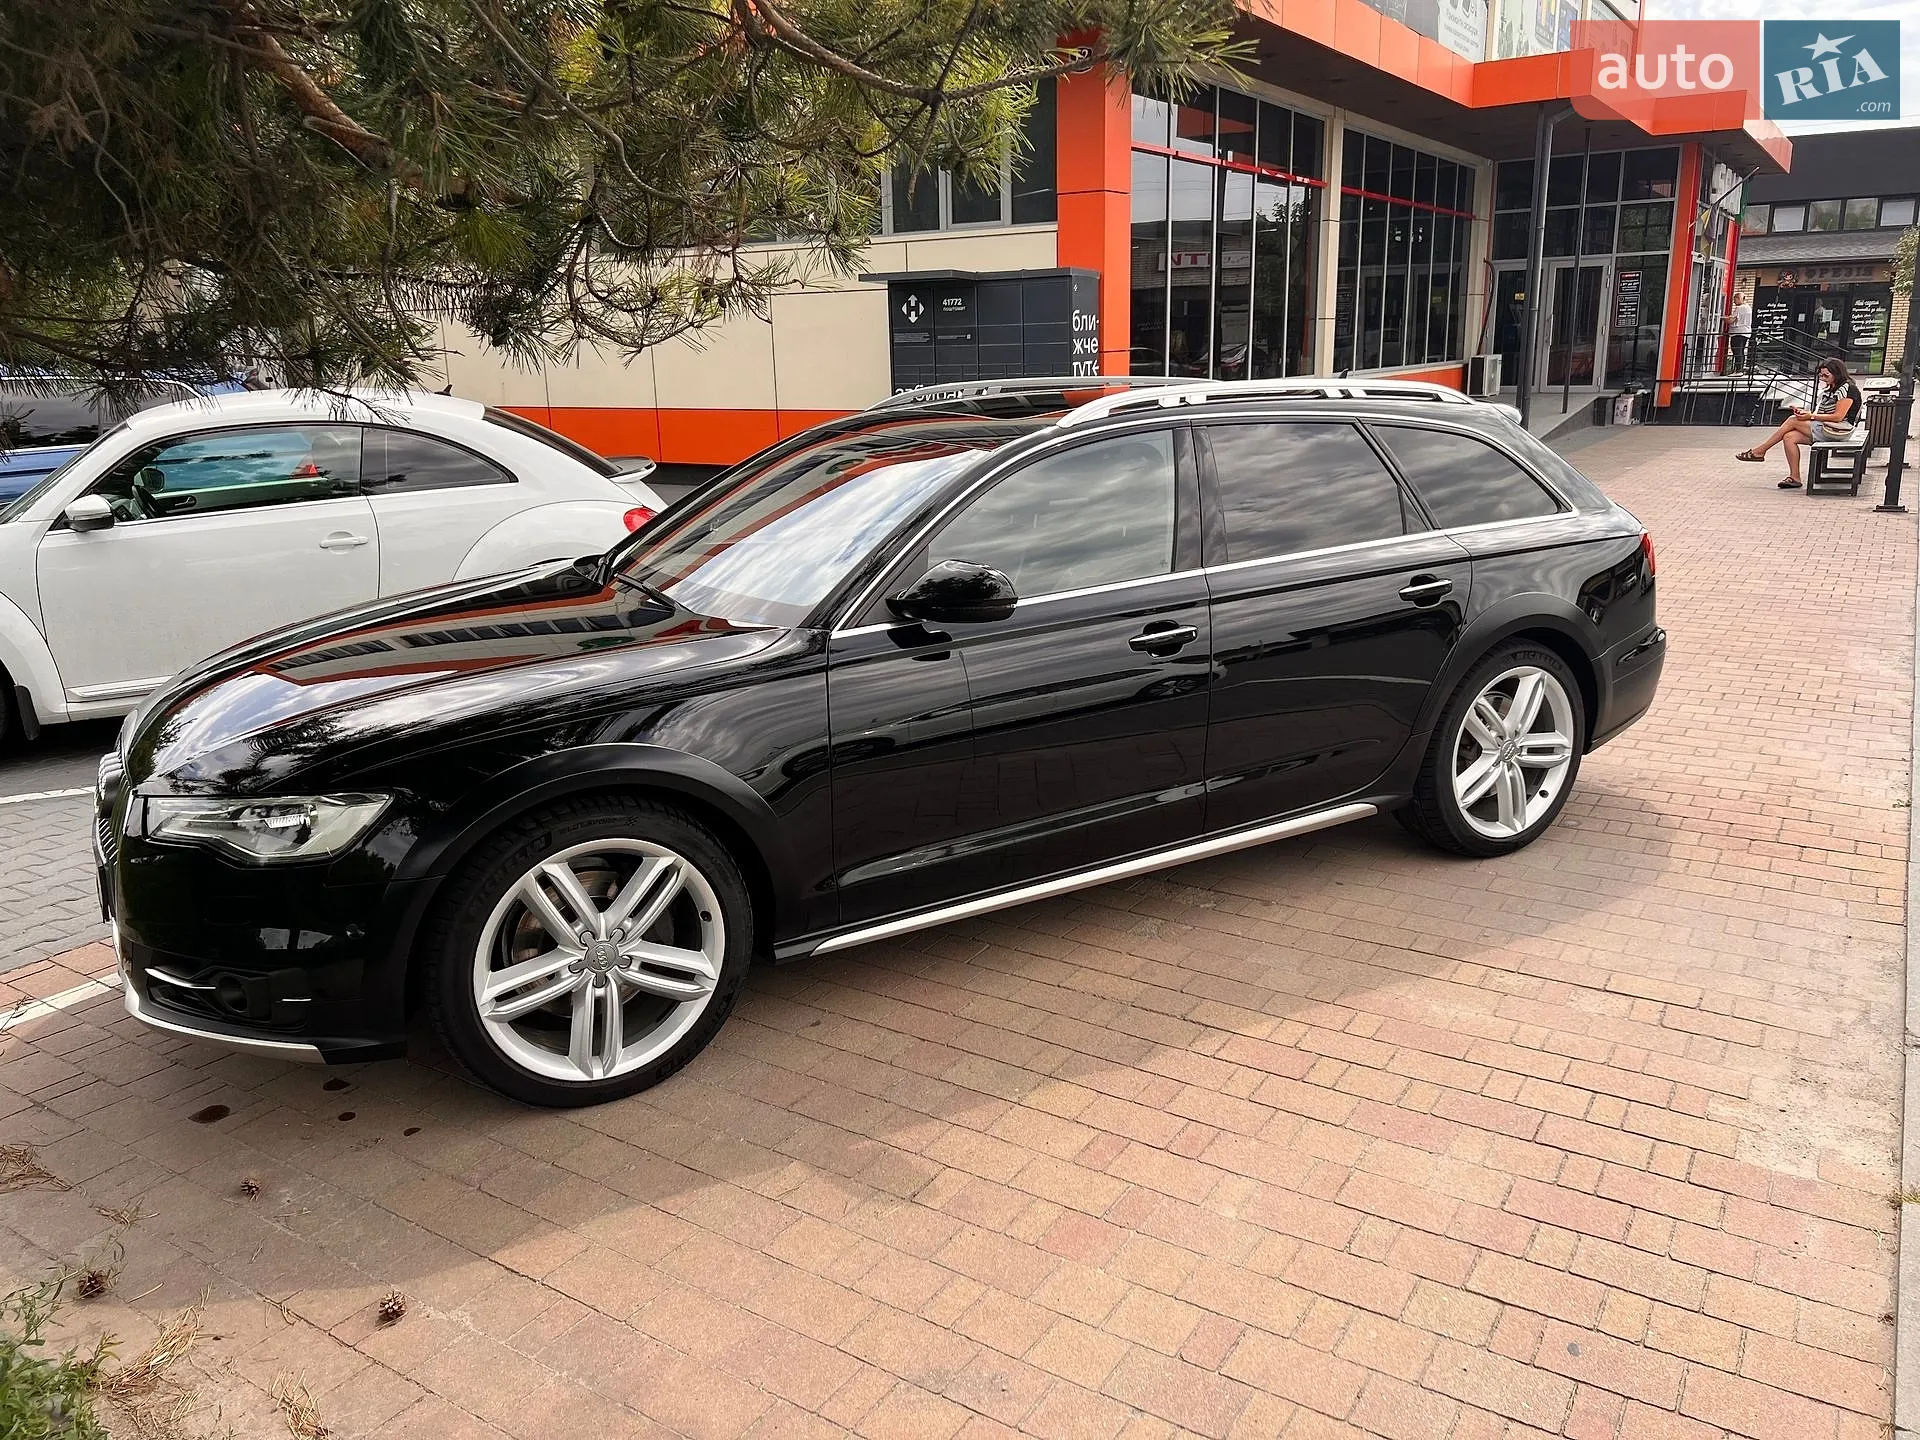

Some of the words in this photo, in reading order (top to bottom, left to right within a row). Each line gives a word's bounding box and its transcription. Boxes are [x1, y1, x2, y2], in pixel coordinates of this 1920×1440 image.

[942, 298, 963, 306] 41772
[1072, 309, 1100, 331] бли-
[1072, 337, 1099, 355] жче
